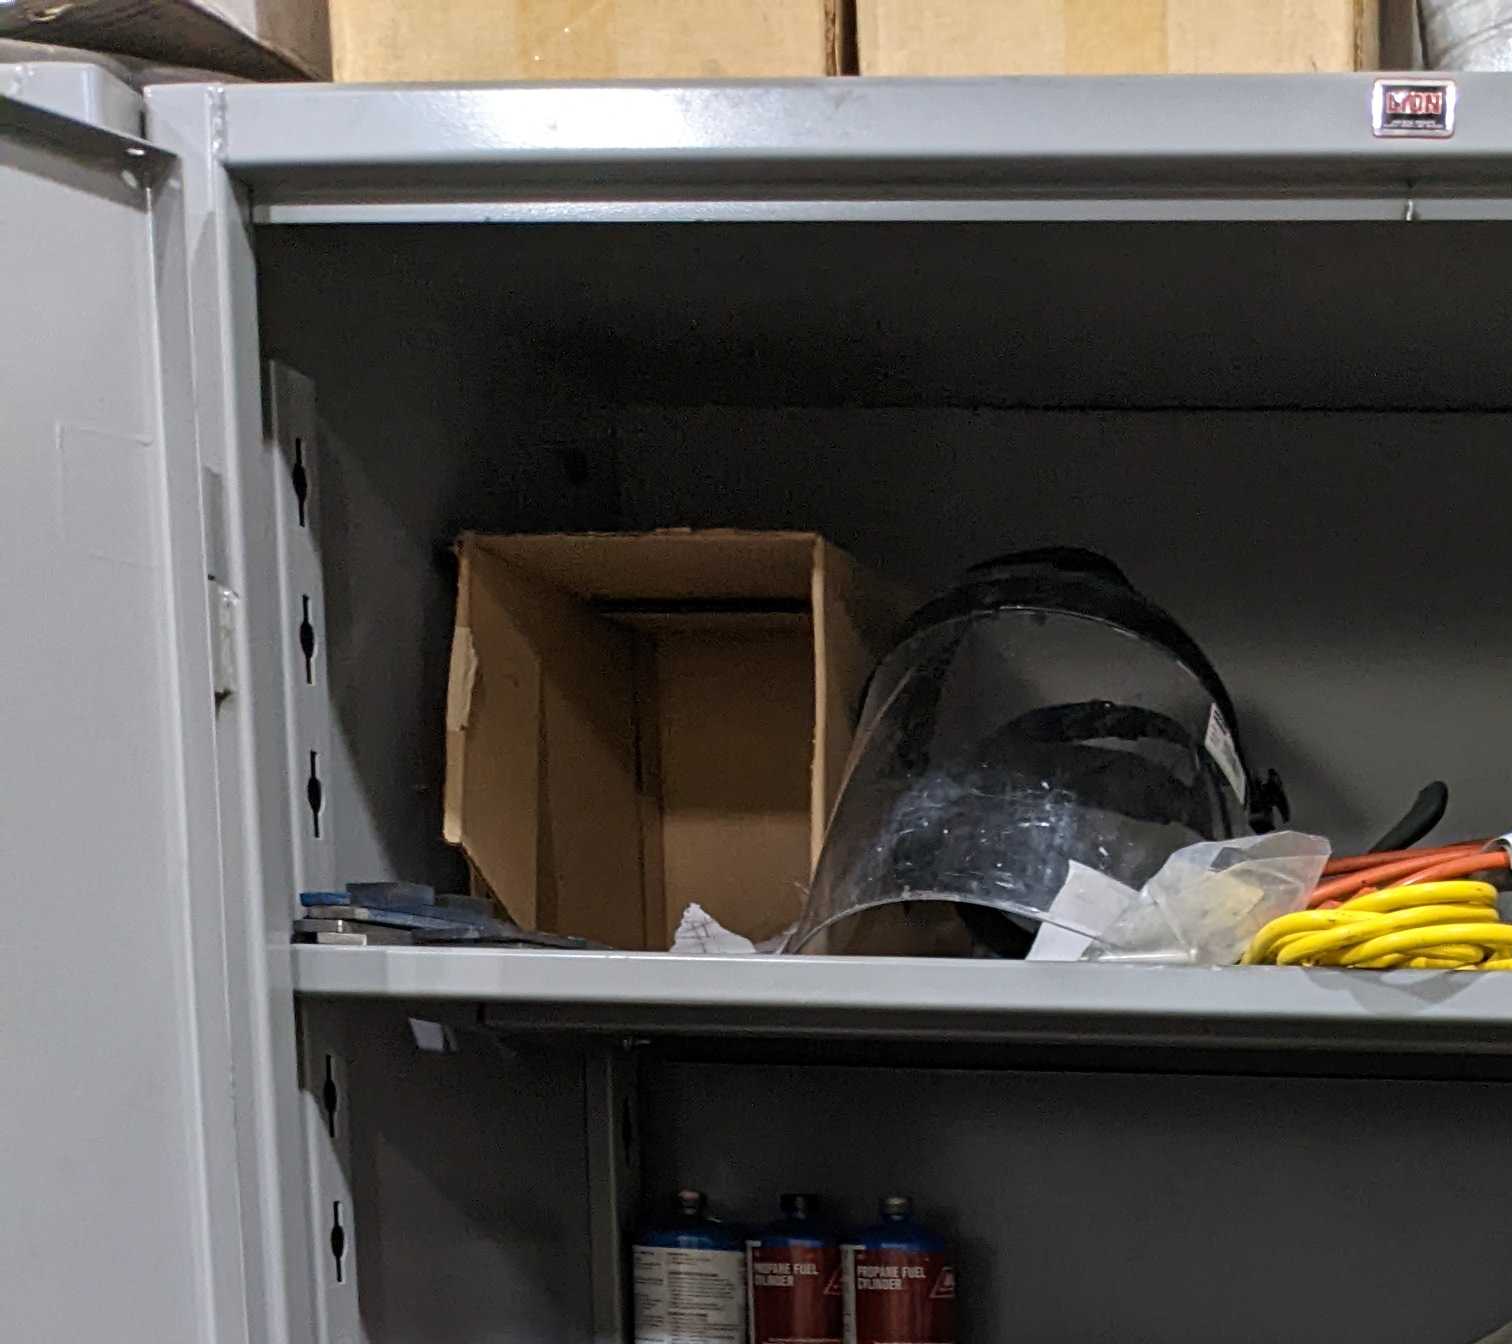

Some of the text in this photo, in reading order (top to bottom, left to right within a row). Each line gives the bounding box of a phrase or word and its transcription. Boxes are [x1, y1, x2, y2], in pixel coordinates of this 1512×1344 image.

[794, 1264, 819, 1276] FUEL
[857, 1265, 926, 1279] PROPANE FUEL
